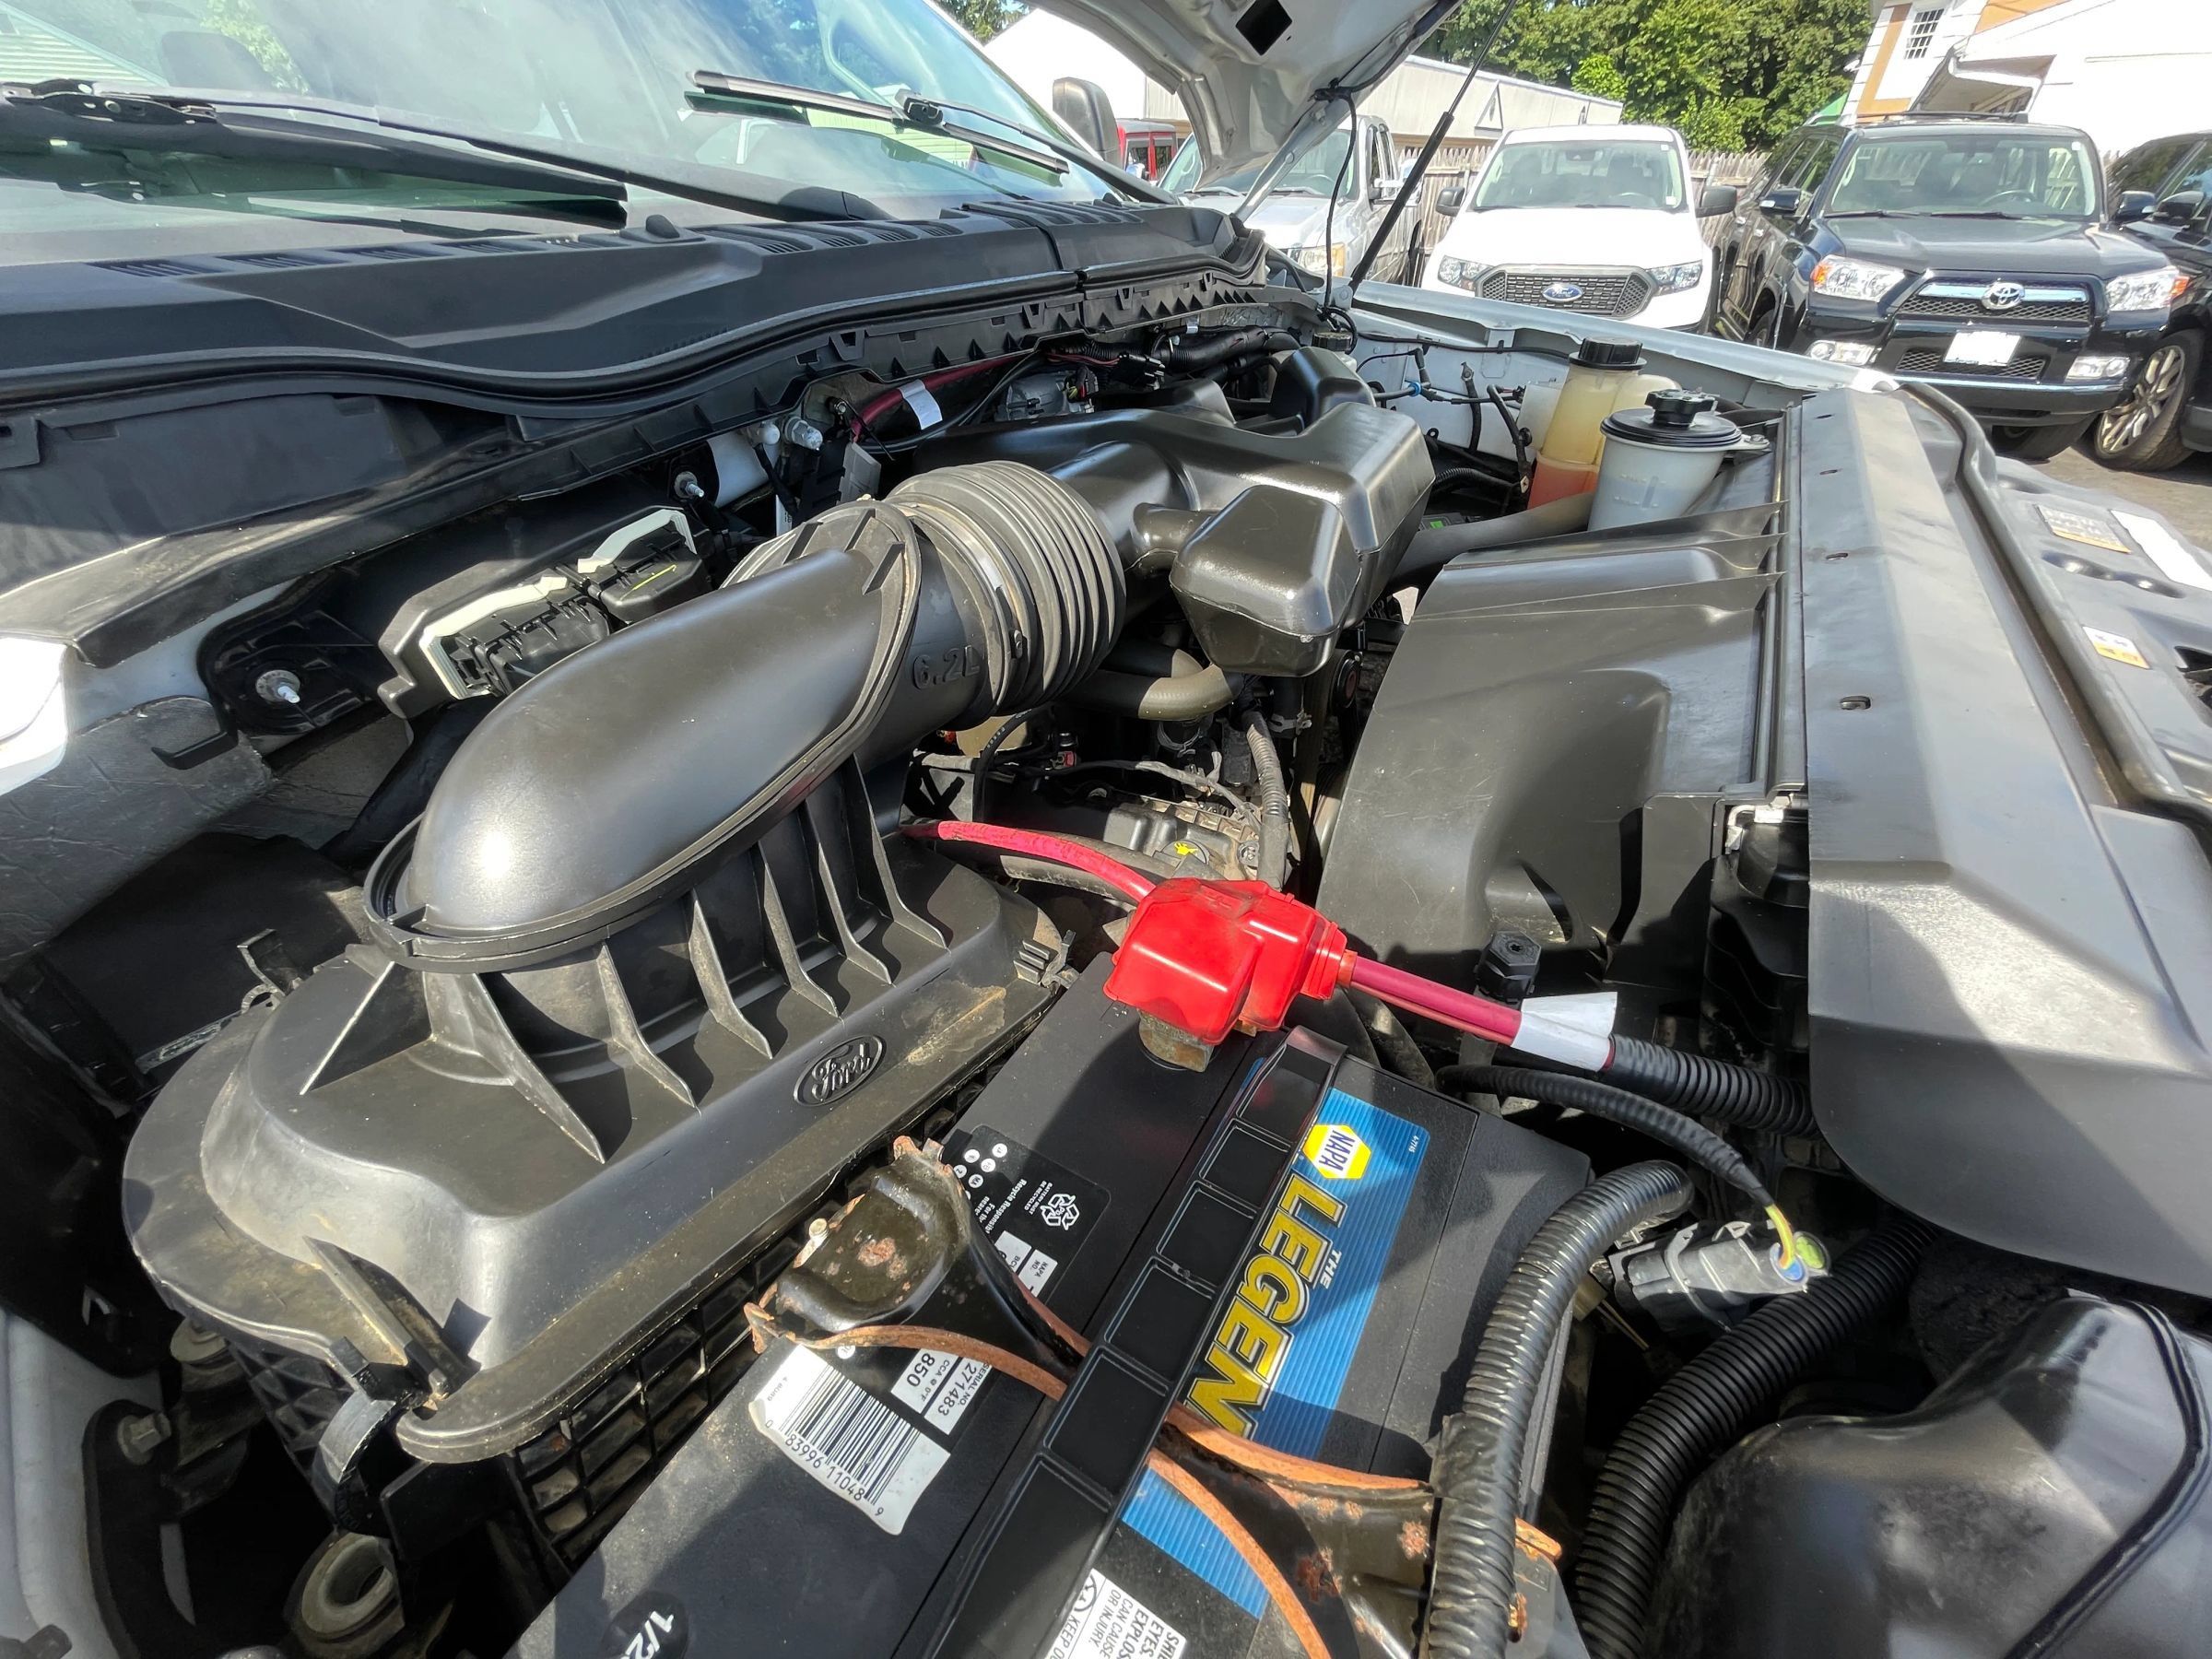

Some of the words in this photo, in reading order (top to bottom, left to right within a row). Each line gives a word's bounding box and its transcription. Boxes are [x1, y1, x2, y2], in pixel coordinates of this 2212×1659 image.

[911, 644, 981, 691] 6.2L
[811, 1042, 871, 1102] Ford
[1318, 1129, 1356, 1171] NAPA
[1006, 1178, 1028, 1202] Recycle
[1024, 1187, 1043, 1211] RECYCLED
[1038, 1182, 1053, 1203] BATTERY
[1039, 1180, 1048, 1189] BE
[974, 1195, 991, 1217] neare
[983, 1202, 996, 1215] For
[1029, 1201, 1041, 1215] MUST
[1034, 1261, 1049, 1278] NAPA
[1318, 1249, 1343, 1289] THE
[1184, 1173, 1348, 1440] LEGEN
[906, 1352, 935, 1387] 850
[935, 1359, 950, 1377] CCA
[968, 1362, 990, 1390] SERIAL
[938, 1362, 977, 1417] 271483
[958, 1392, 971, 1406] NO.
[765, 1419, 774, 1429] 0
[784, 1433, 825, 1469] 83996
[825, 1465, 866, 1502] 11048
[1107, 1589, 1122, 1607] OR
[1115, 1597, 1134, 1624] CAN
[619, 1610, 675, 1659] 1/2
[1060, 1614, 1081, 1649] KEEP
[1088, 1604, 1115, 1648] INJURY.
[1100, 1621, 1124, 1659] CAUSE
[1117, 1608, 1149, 1659] EXPLOS
[1138, 1619, 1165, 1658] EYES.
